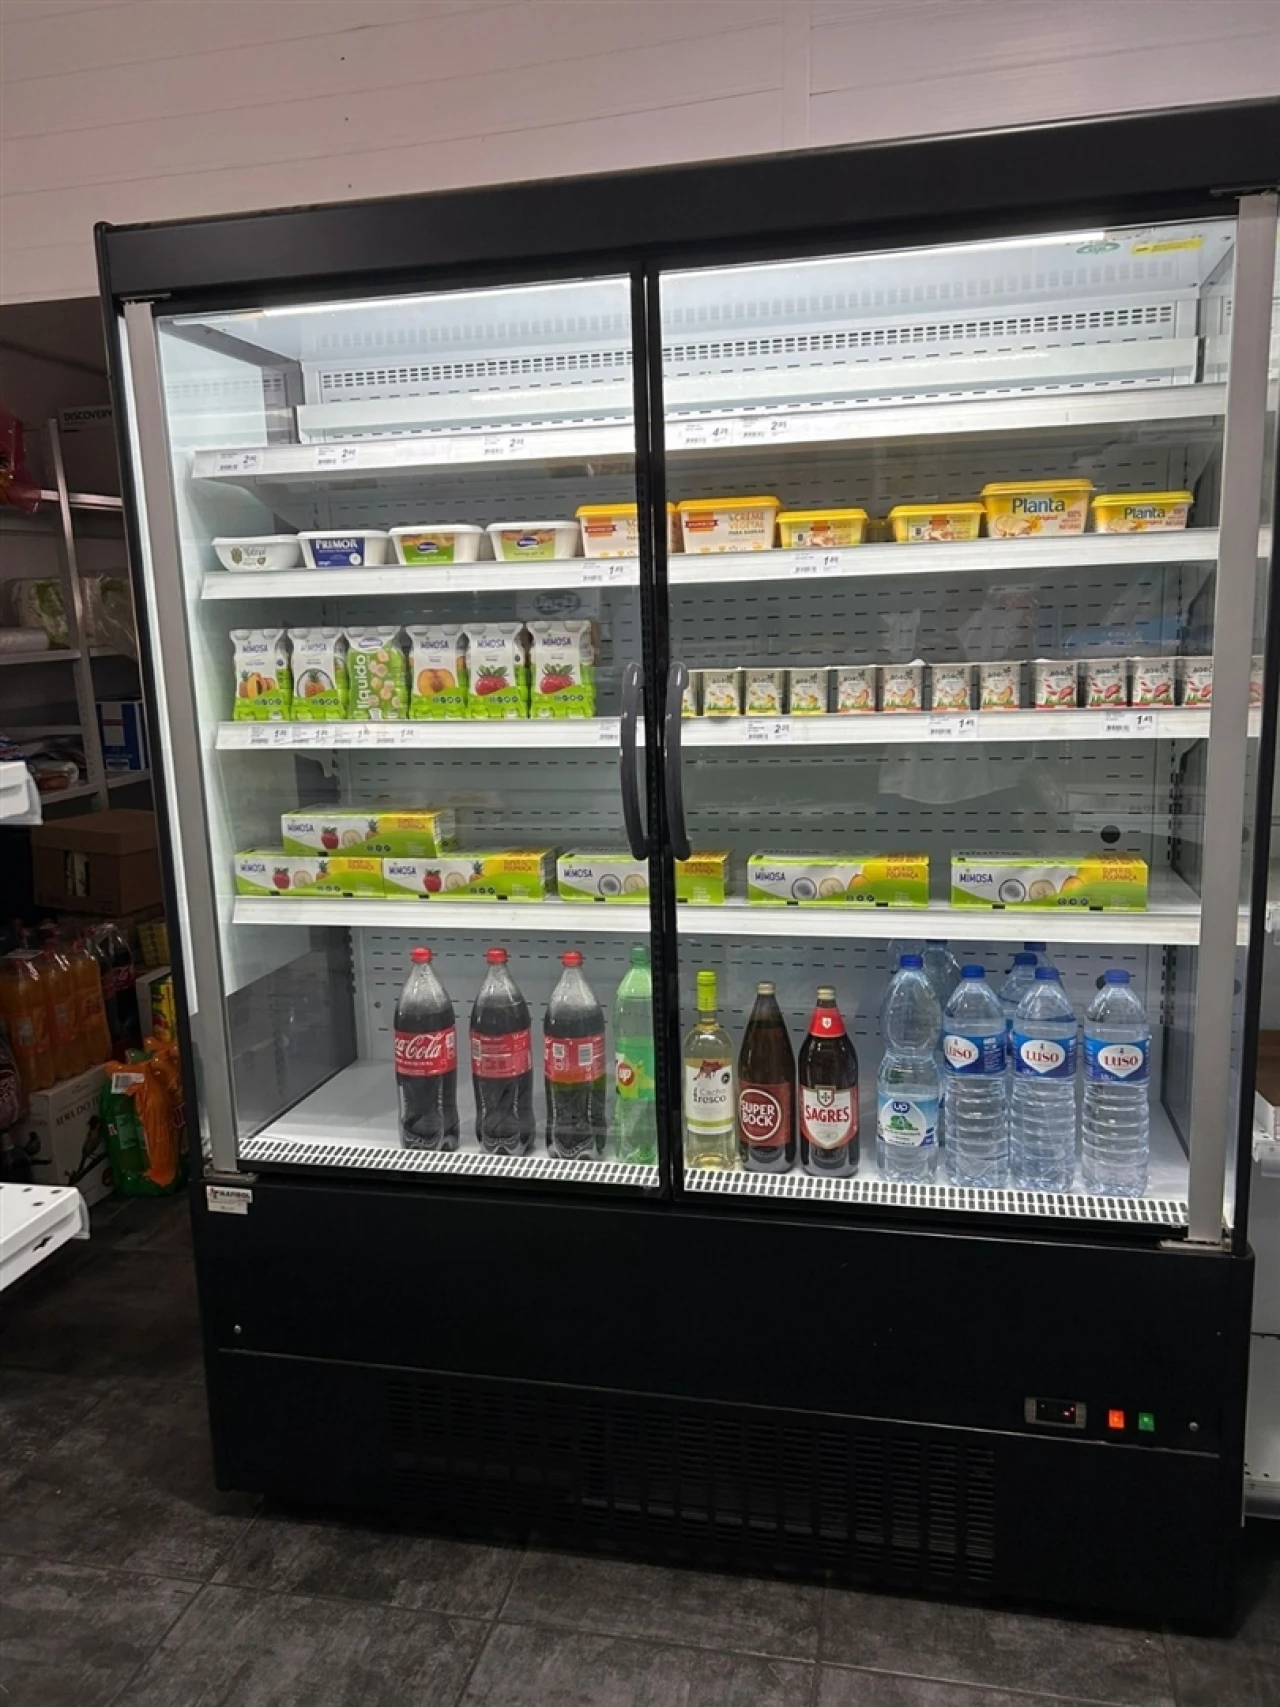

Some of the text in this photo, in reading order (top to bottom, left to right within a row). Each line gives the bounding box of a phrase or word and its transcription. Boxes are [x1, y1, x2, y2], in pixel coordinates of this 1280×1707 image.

[1012, 497, 1065, 513] Planta
[1124, 506, 1165, 519] Planta
[316, 538, 358, 550] PRIMOR
[420, 640, 449, 649] MIMOSA
[477, 639, 505, 649] MIMOSA
[542, 637, 571, 646] MIMOSA
[242, 644, 268, 653] MIMOSA
[287, 823, 315, 833] MIMOSA
[241, 863, 266, 873] MIMOSA
[388, 865, 417, 875] MIMOSA
[564, 868, 593, 878] MIMOSA
[755, 872, 786, 881] MIMOSA
[959, 873, 993, 883] MIMOSA
[1026, 1051, 1059, 1063] LUSO
[1104, 1056, 1138, 1066] LUSO
[741, 1101, 775, 1116] SUPER
[805, 1104, 850, 1122] SAGRES
[742, 1114, 774, 1127] BOCK
